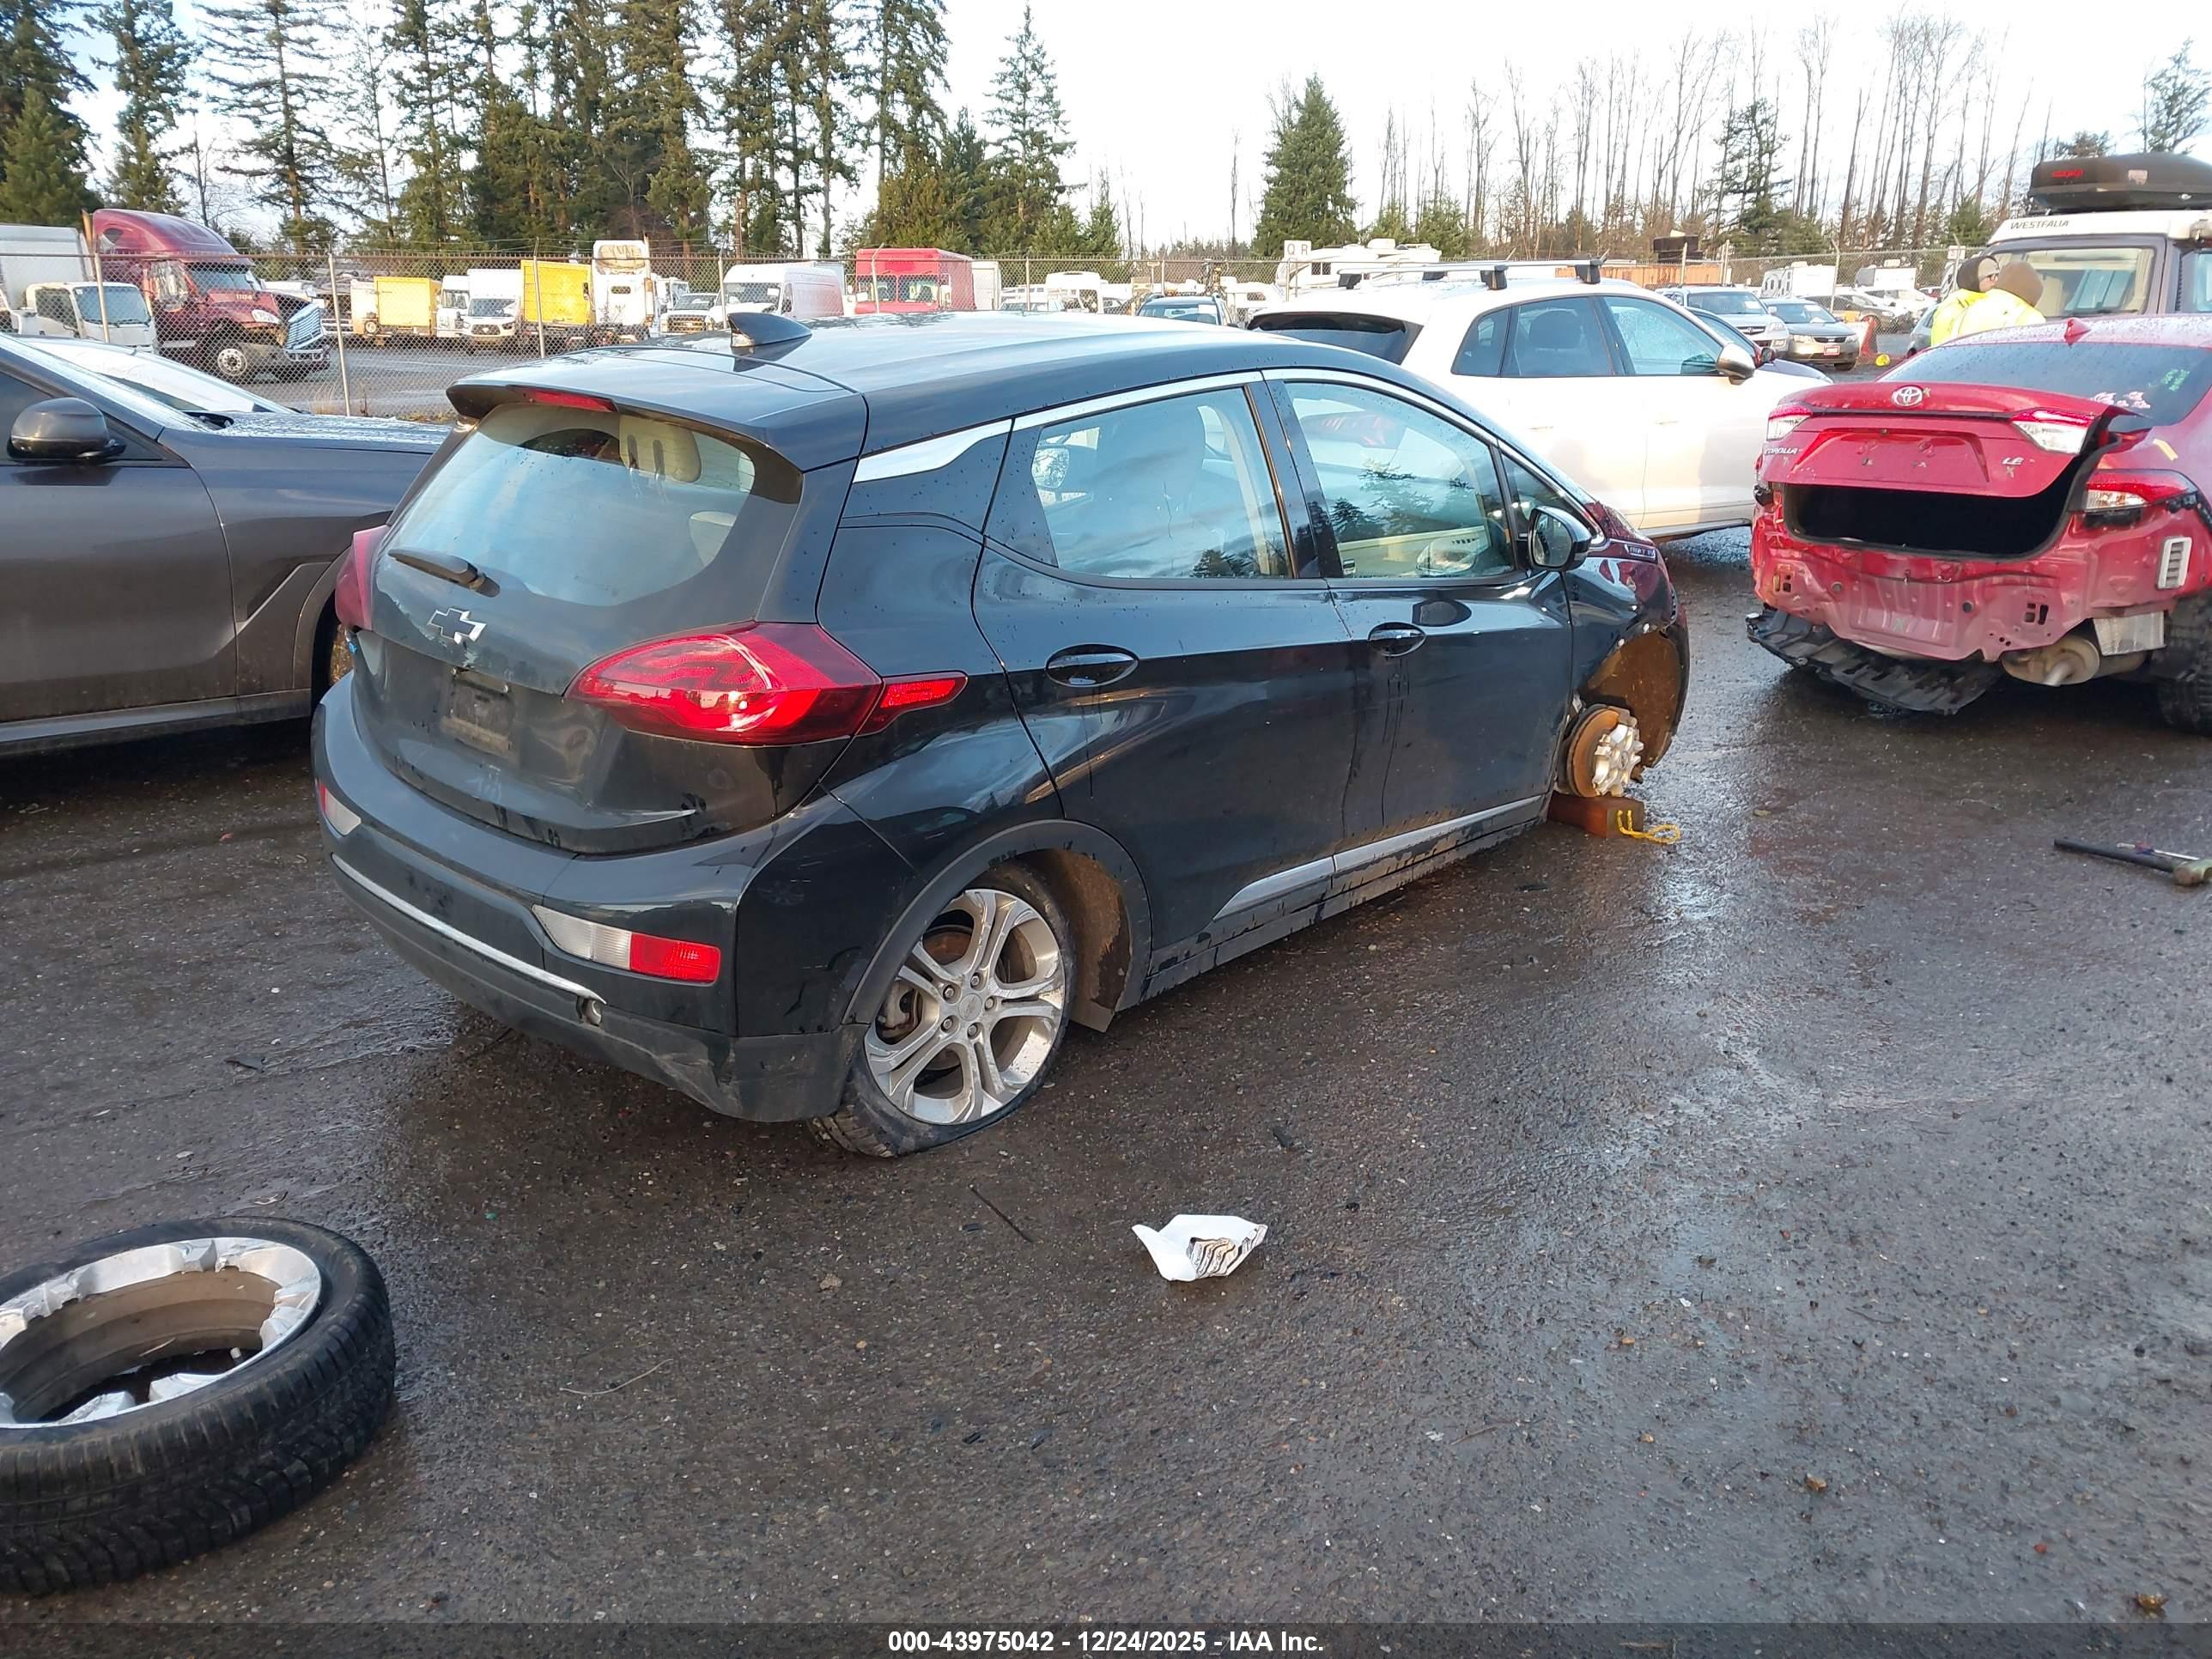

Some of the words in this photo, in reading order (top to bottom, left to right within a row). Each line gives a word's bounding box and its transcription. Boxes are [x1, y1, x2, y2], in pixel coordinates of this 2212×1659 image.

[2010, 220, 2069, 229] WESTFALIA
[1287, 243, 1296, 256] Q
[1301, 244, 1308, 255] R
